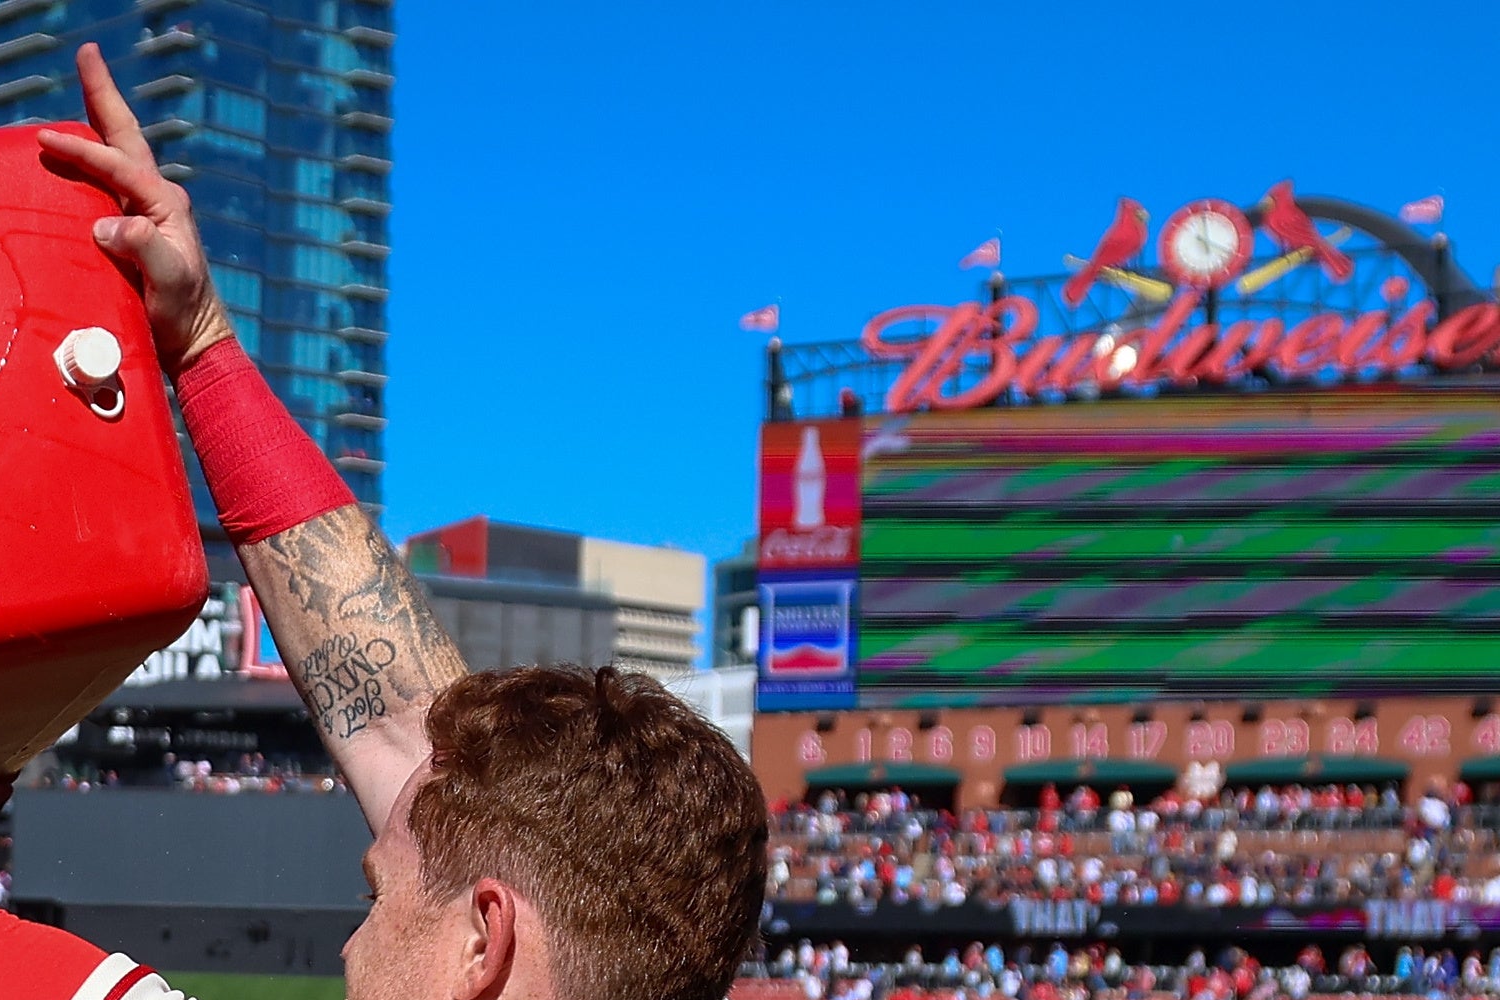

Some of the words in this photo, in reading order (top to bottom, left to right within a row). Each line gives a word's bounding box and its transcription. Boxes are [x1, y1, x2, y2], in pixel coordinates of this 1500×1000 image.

[862, 276, 1500, 412] Budweise
[1017, 724, 1051, 761] 10
[1129, 720, 1168, 761] 17
[1400, 715, 1450, 755] 42
